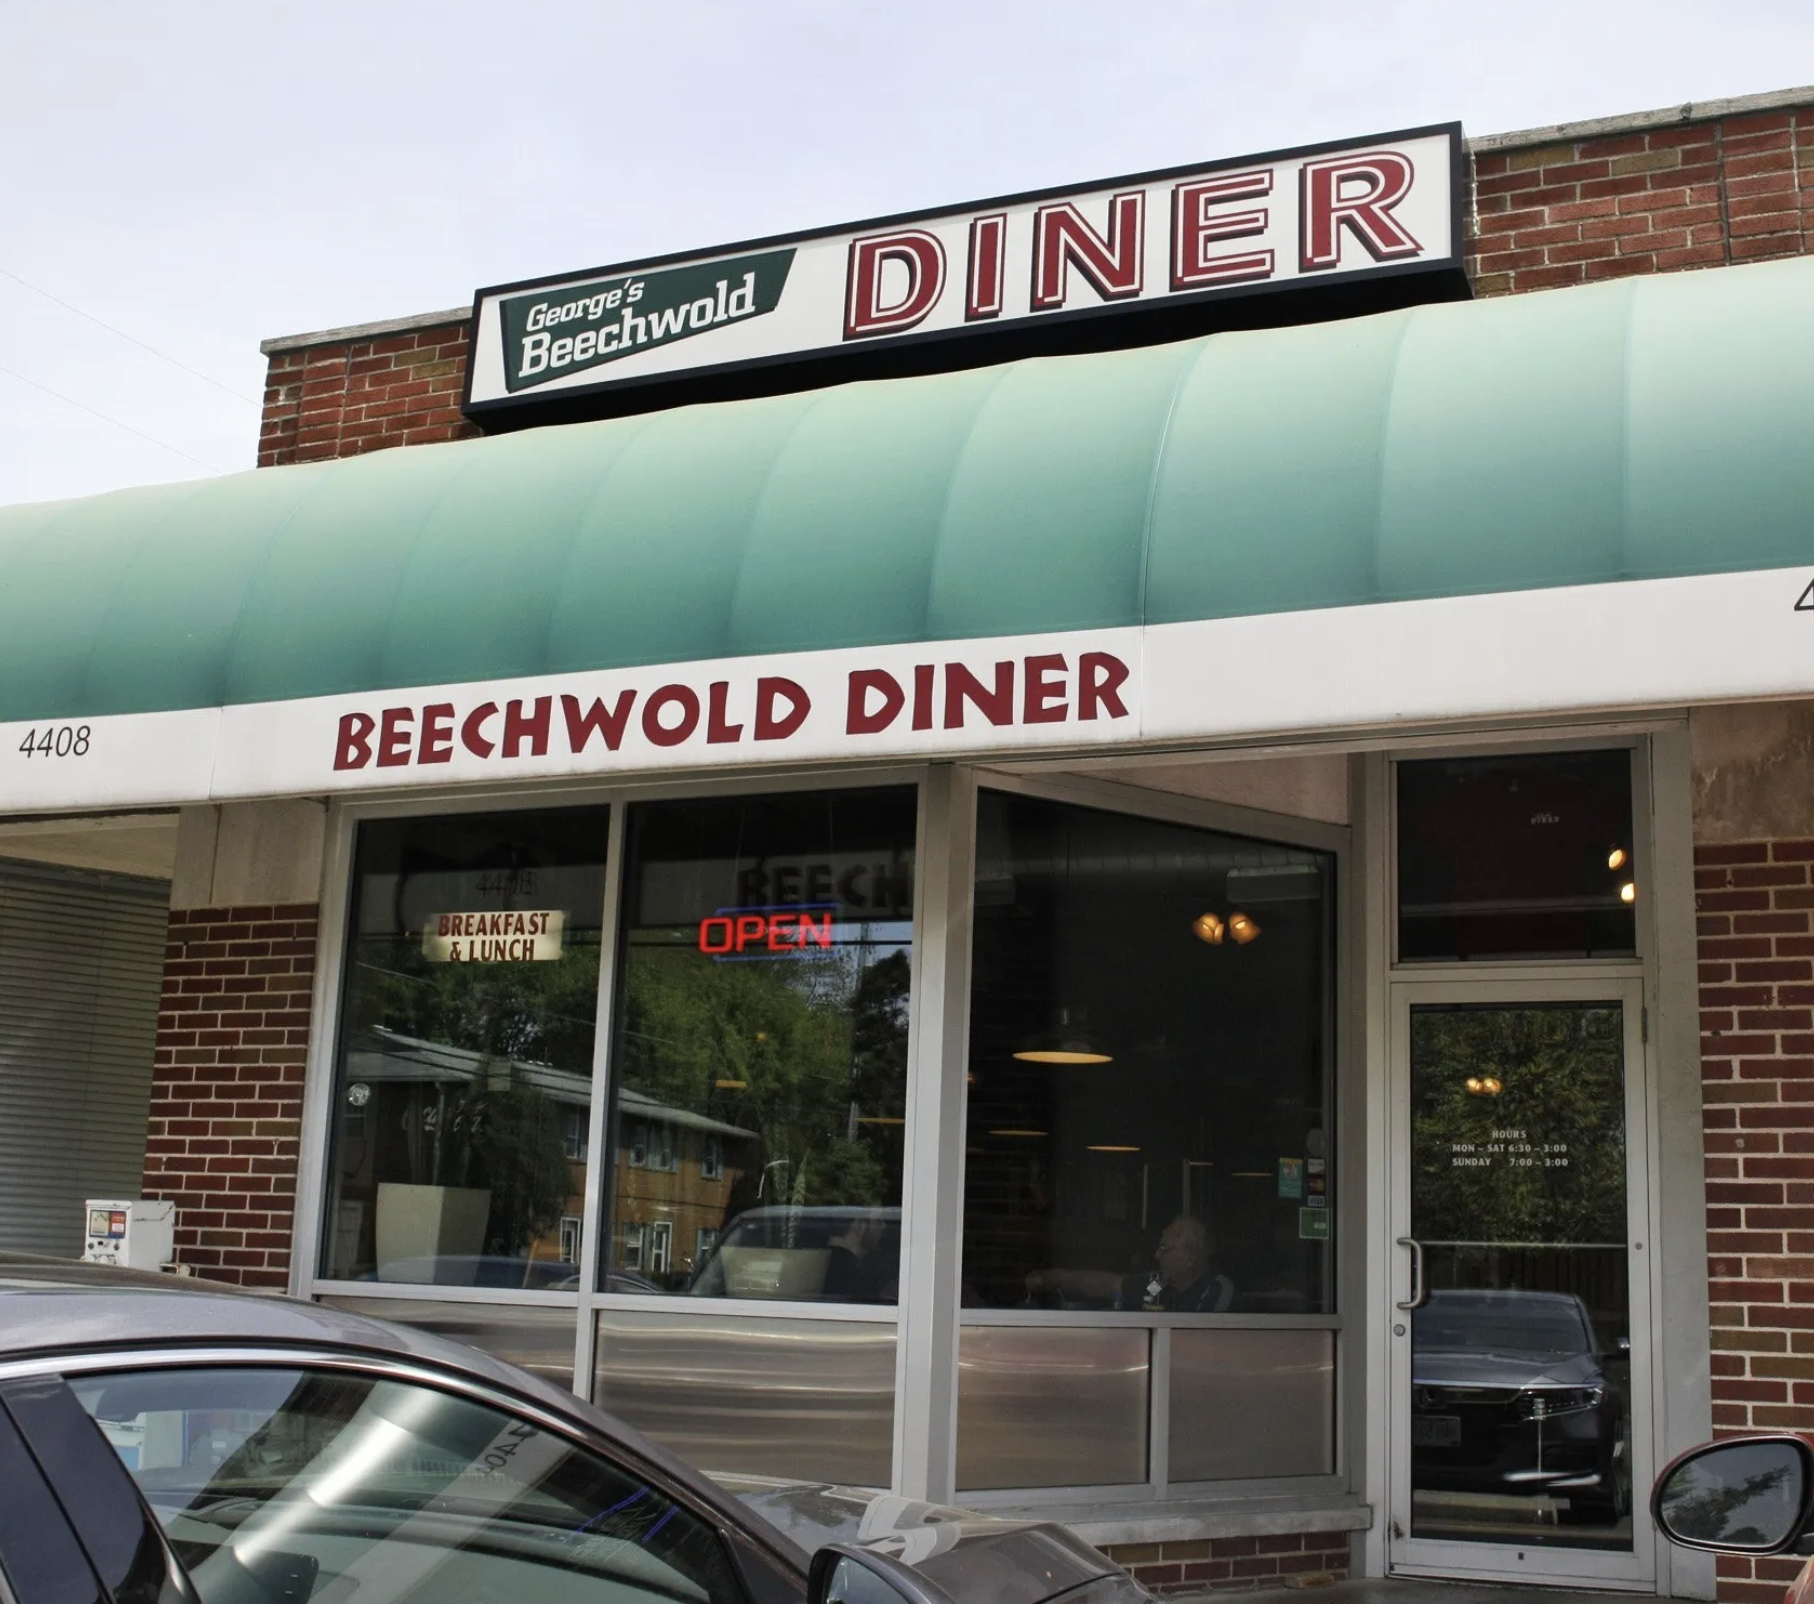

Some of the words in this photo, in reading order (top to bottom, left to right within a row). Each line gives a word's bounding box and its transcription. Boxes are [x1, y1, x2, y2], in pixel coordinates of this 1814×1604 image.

[843, 151, 1425, 340] DINER
[526, 278, 645, 333] George's
[518, 271, 756, 379] Beechwold
[334, 676, 812, 771] BEECHWOLD
[846, 652, 1130, 736] DINER
[19, 725, 91, 758] 4408
[438, 912, 550, 937] BREAKFAST
[698, 913, 832, 953] OPEN
[450, 941, 462, 962] &
[469, 939, 535, 962] LUNCH
[1452, 1144, 1475, 1153] MON
[1487, 1144, 1505, 1153] SAT
[1508, 1144, 1532, 1153] 6:30
[1543, 1144, 1568, 1153] 3:00
[1492, 1130, 1527, 1139] HOURS
[1452, 1157, 1492, 1167] SUNDAY
[1509, 1158, 1533, 1167] 7:00
[1544, 1158, 1569, 1167] 3:00
